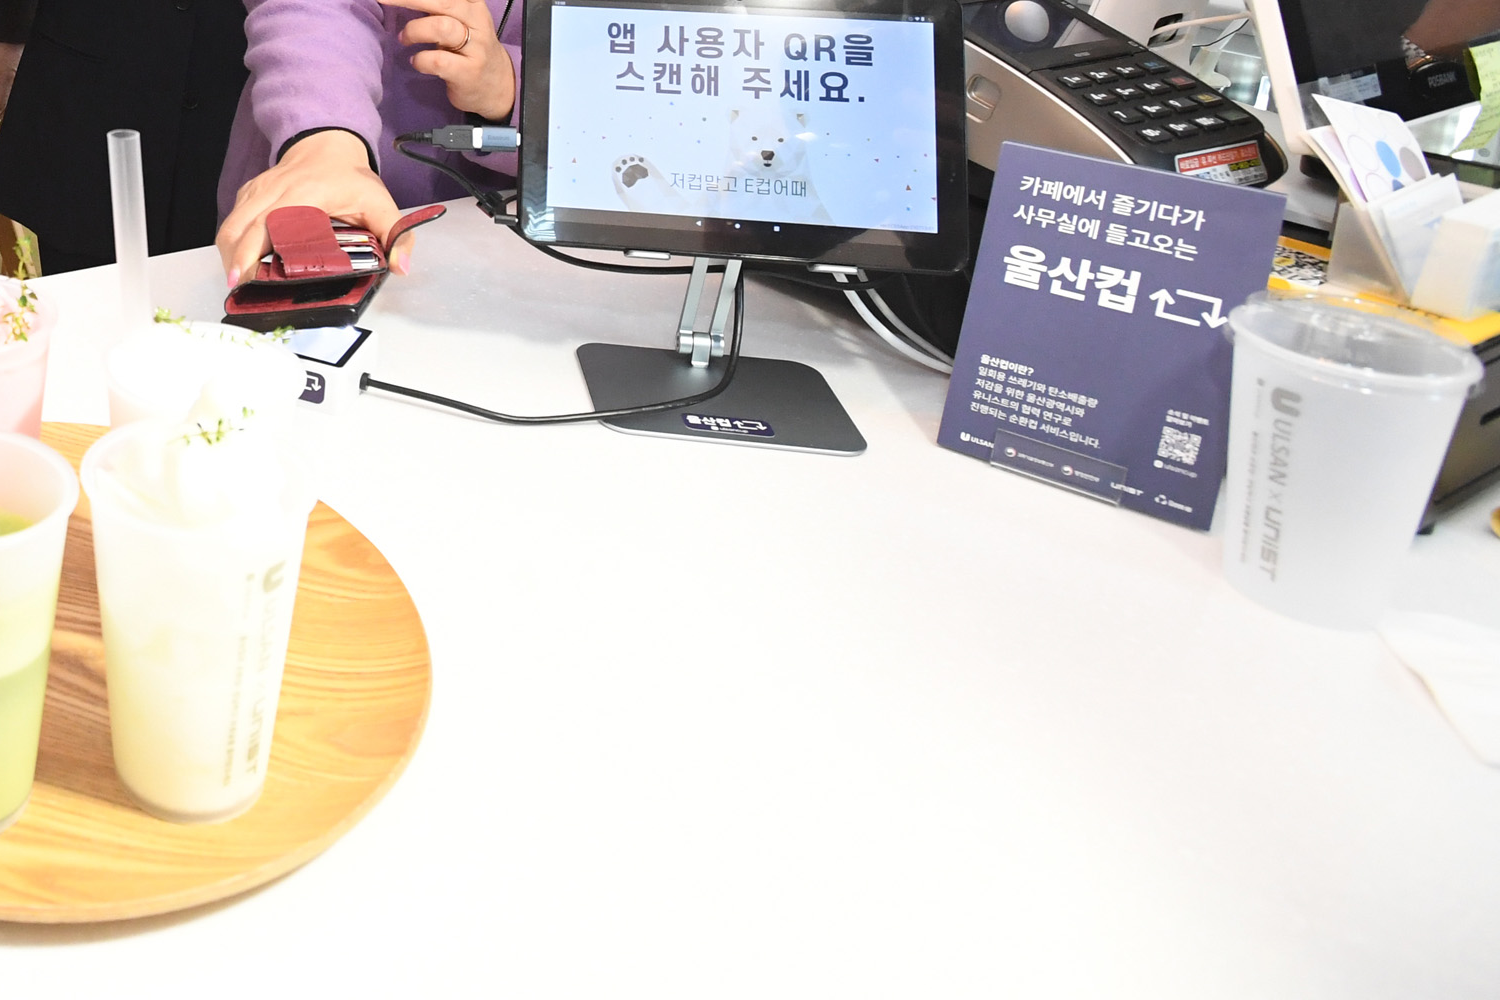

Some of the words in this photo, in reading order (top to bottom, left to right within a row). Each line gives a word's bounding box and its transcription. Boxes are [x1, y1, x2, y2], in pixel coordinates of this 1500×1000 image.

[607, 22, 636, 55] 앱
[656, 25, 765, 60] 사용자
[783, 33, 875, 67] QR을
[615, 61, 720, 96] 스캔해
[741, 67, 866, 103] 주세요.
[670, 172, 738, 193] 저컵말고
[745, 178, 807, 197] E컵어때
[1019, 175, 1107, 211] 카페에서
[1112, 193, 1206, 232] 즐기다가
[1013, 204, 1101, 240] 사무실에
[1105, 222, 1199, 261] 들고오는
[1003, 244, 1142, 314] 울산컵
[980, 354, 1034, 376] 울산컵이란?
[972, 390, 1020, 411] 유니스트의
[1021, 404, 1041, 418] 협력
[1042, 411, 1073, 427] 연구로
[975, 378, 1004, 393] 저감을
[1005, 387, 1025, 400] 위한
[1026, 393, 1086, 418] 울산광역시와
[978, 366, 1006, 381] 일회용
[1007, 375, 1046, 393] 쓰레기와
[1048, 386, 1099, 408] 탄소배출량
[970, 402, 1007, 420] 진행되는
[1009, 413, 1038, 430] 순환컵
[1040, 423, 1101, 448] 서비스입니다.
[1268, 418, 1293, 487] ULSAN
